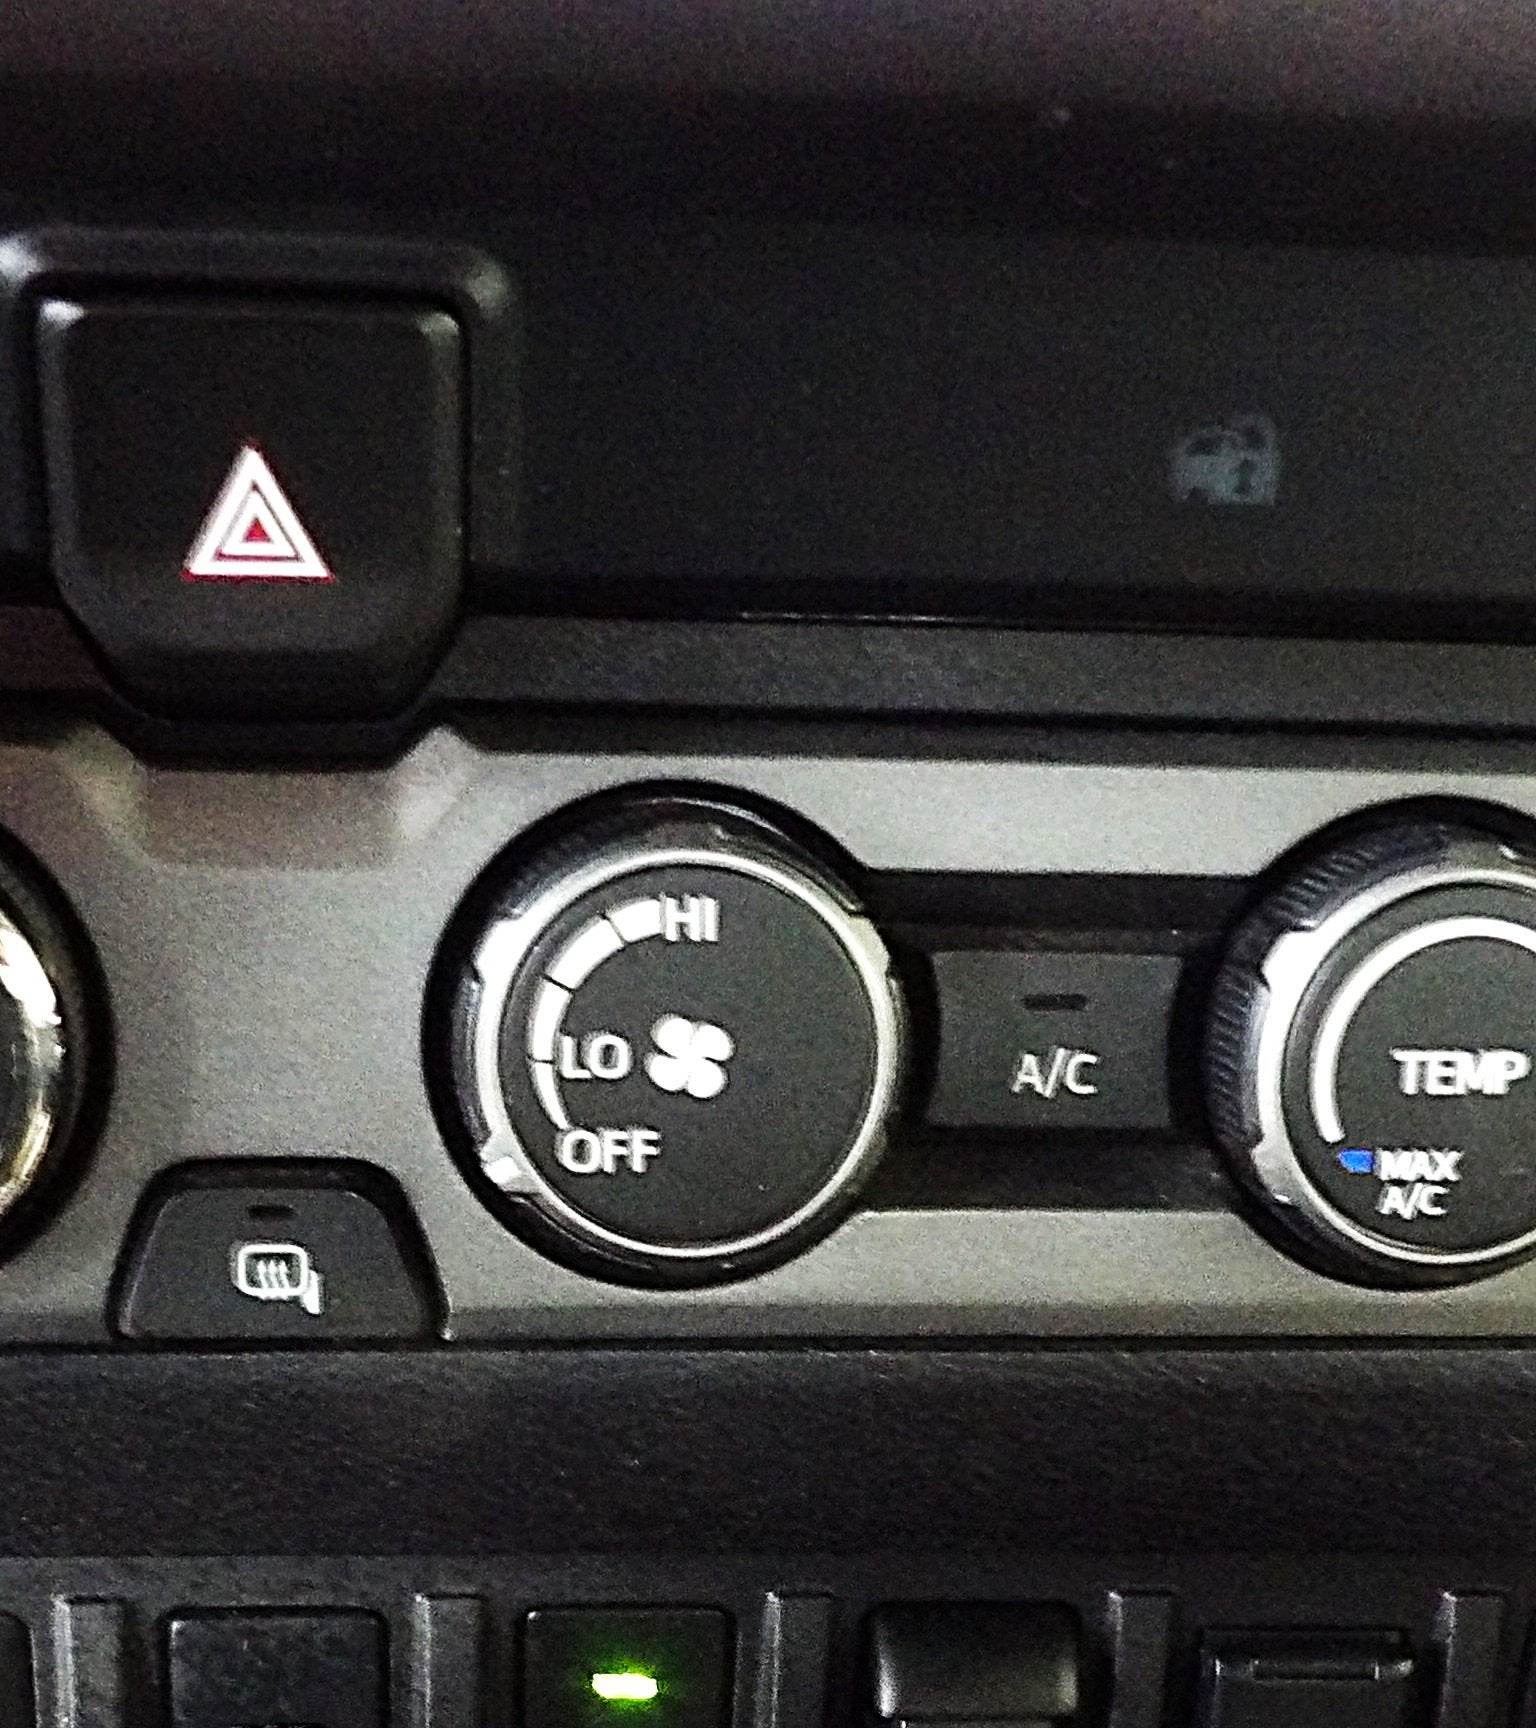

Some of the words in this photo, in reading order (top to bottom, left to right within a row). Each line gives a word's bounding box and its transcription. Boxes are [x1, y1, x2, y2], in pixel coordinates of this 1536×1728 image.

[664, 896, 720, 943] HI
[561, 1033, 632, 1081] LO
[1011, 1047, 1098, 1099] A/C
[1391, 1049, 1531, 1095] TEMP
[559, 1127, 660, 1174] OFF
[1377, 1150, 1461, 1183] MAX
[1379, 1182, 1446, 1220] A/C
